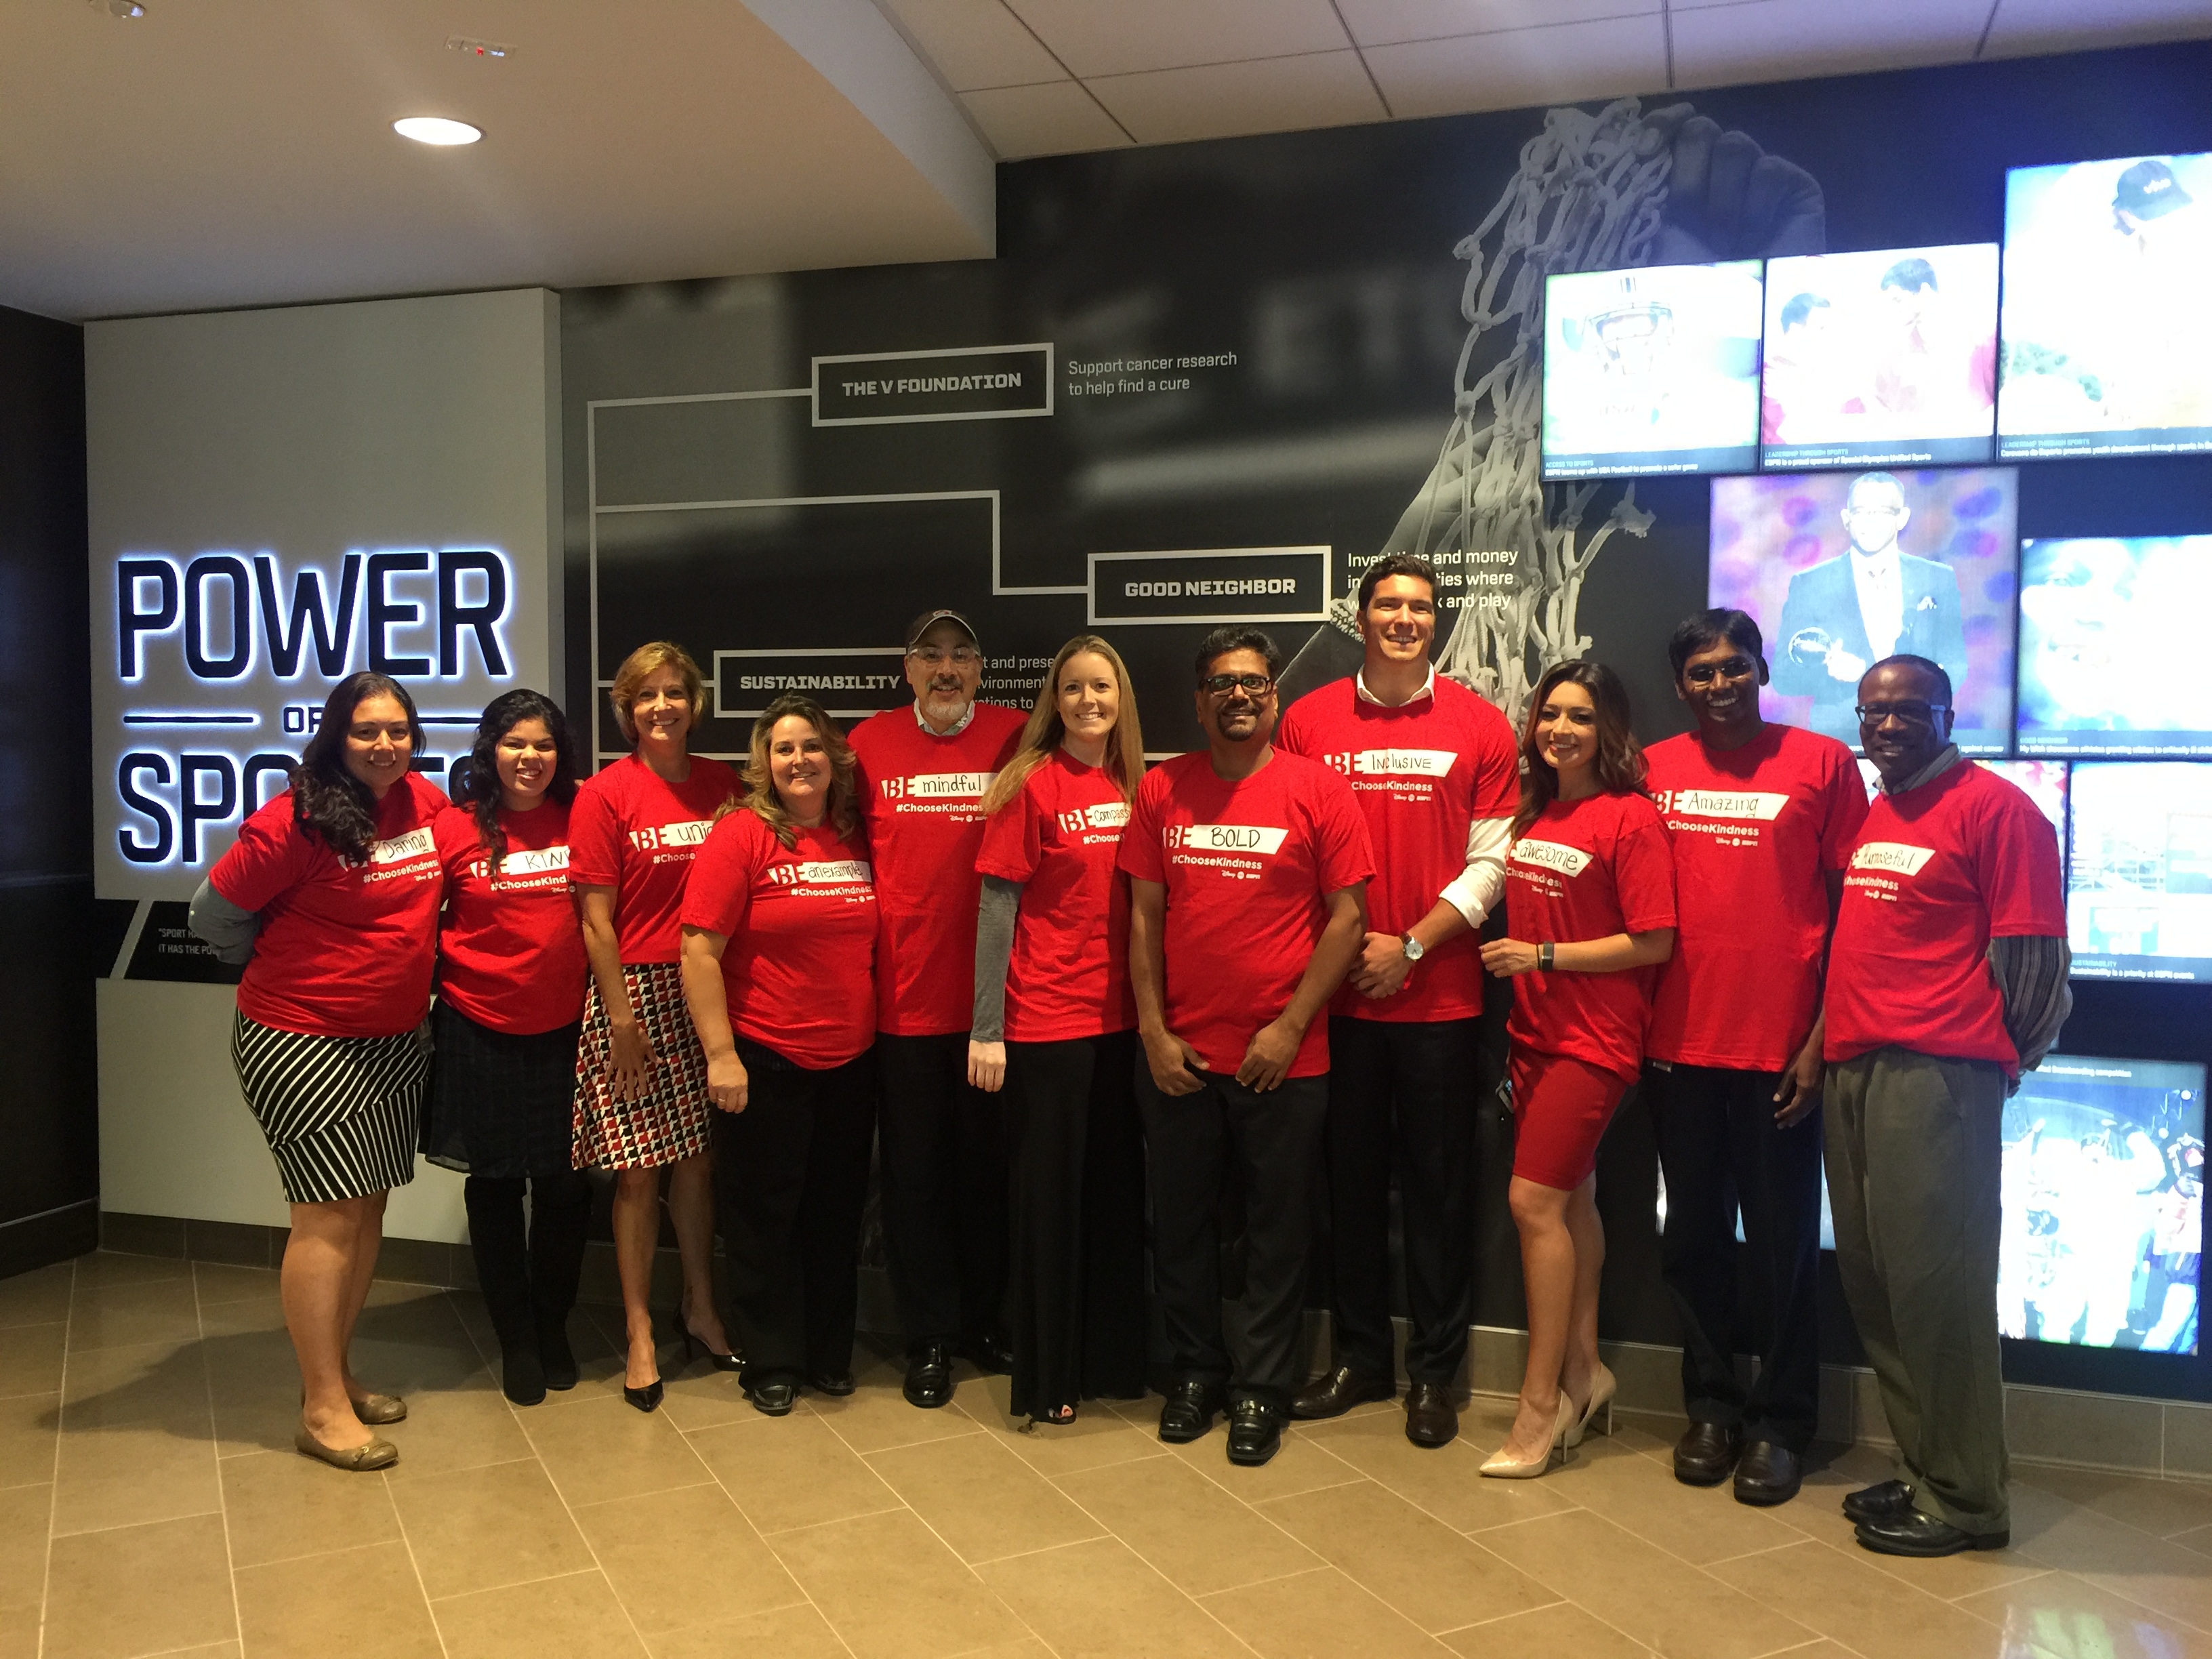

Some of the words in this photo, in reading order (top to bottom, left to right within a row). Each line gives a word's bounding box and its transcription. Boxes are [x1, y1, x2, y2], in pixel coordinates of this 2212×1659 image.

[1069, 359, 1123, 377] Support
[1127, 359, 1173, 371] cancer
[1177, 352, 1236, 367] research
[842, 382, 877, 396] THE
[881, 380, 893, 394] V
[897, 373, 1021, 393] FOUNDATION
[1069, 383, 1082, 395] to
[1086, 381, 1114, 396] help
[1118, 378, 1143, 392] find
[1148, 381, 1155, 391] a
[1160, 379, 1189, 390] cure
[1433, 550, 1461, 565] and
[1467, 551, 1518, 565] money
[1466, 571, 1513, 585] where
[1126, 582, 1181, 596] GOOD
[1186, 579, 1295, 596] NEIGHBOR
[1447, 596, 1475, 608] and
[1479, 594, 1511, 610] play
[119, 551, 510, 678] POWER
[991, 656, 1015, 668] and
[1019, 658, 1054, 671] prese
[741, 676, 900, 689] SUSTAINABILITY
[1020, 696, 1033, 709] to
[923, 775, 981, 793] mindful
[1351, 781, 1433, 792] ChooseKindness
[896, 803, 983, 813] #ChooseKindnes
[1688, 792, 1759, 819] Amazing
[1211, 827, 1261, 848] BOLD
[383, 834, 429, 859] Daring
[1172, 855, 1262, 869] #ChooseKindness
[1520, 841, 1578, 871] awesome
[791, 885, 873, 897] #ChooseKindness
[159, 943, 165, 953] IT
[167, 945, 184, 954] HAS
[185, 945, 200, 954] THE
